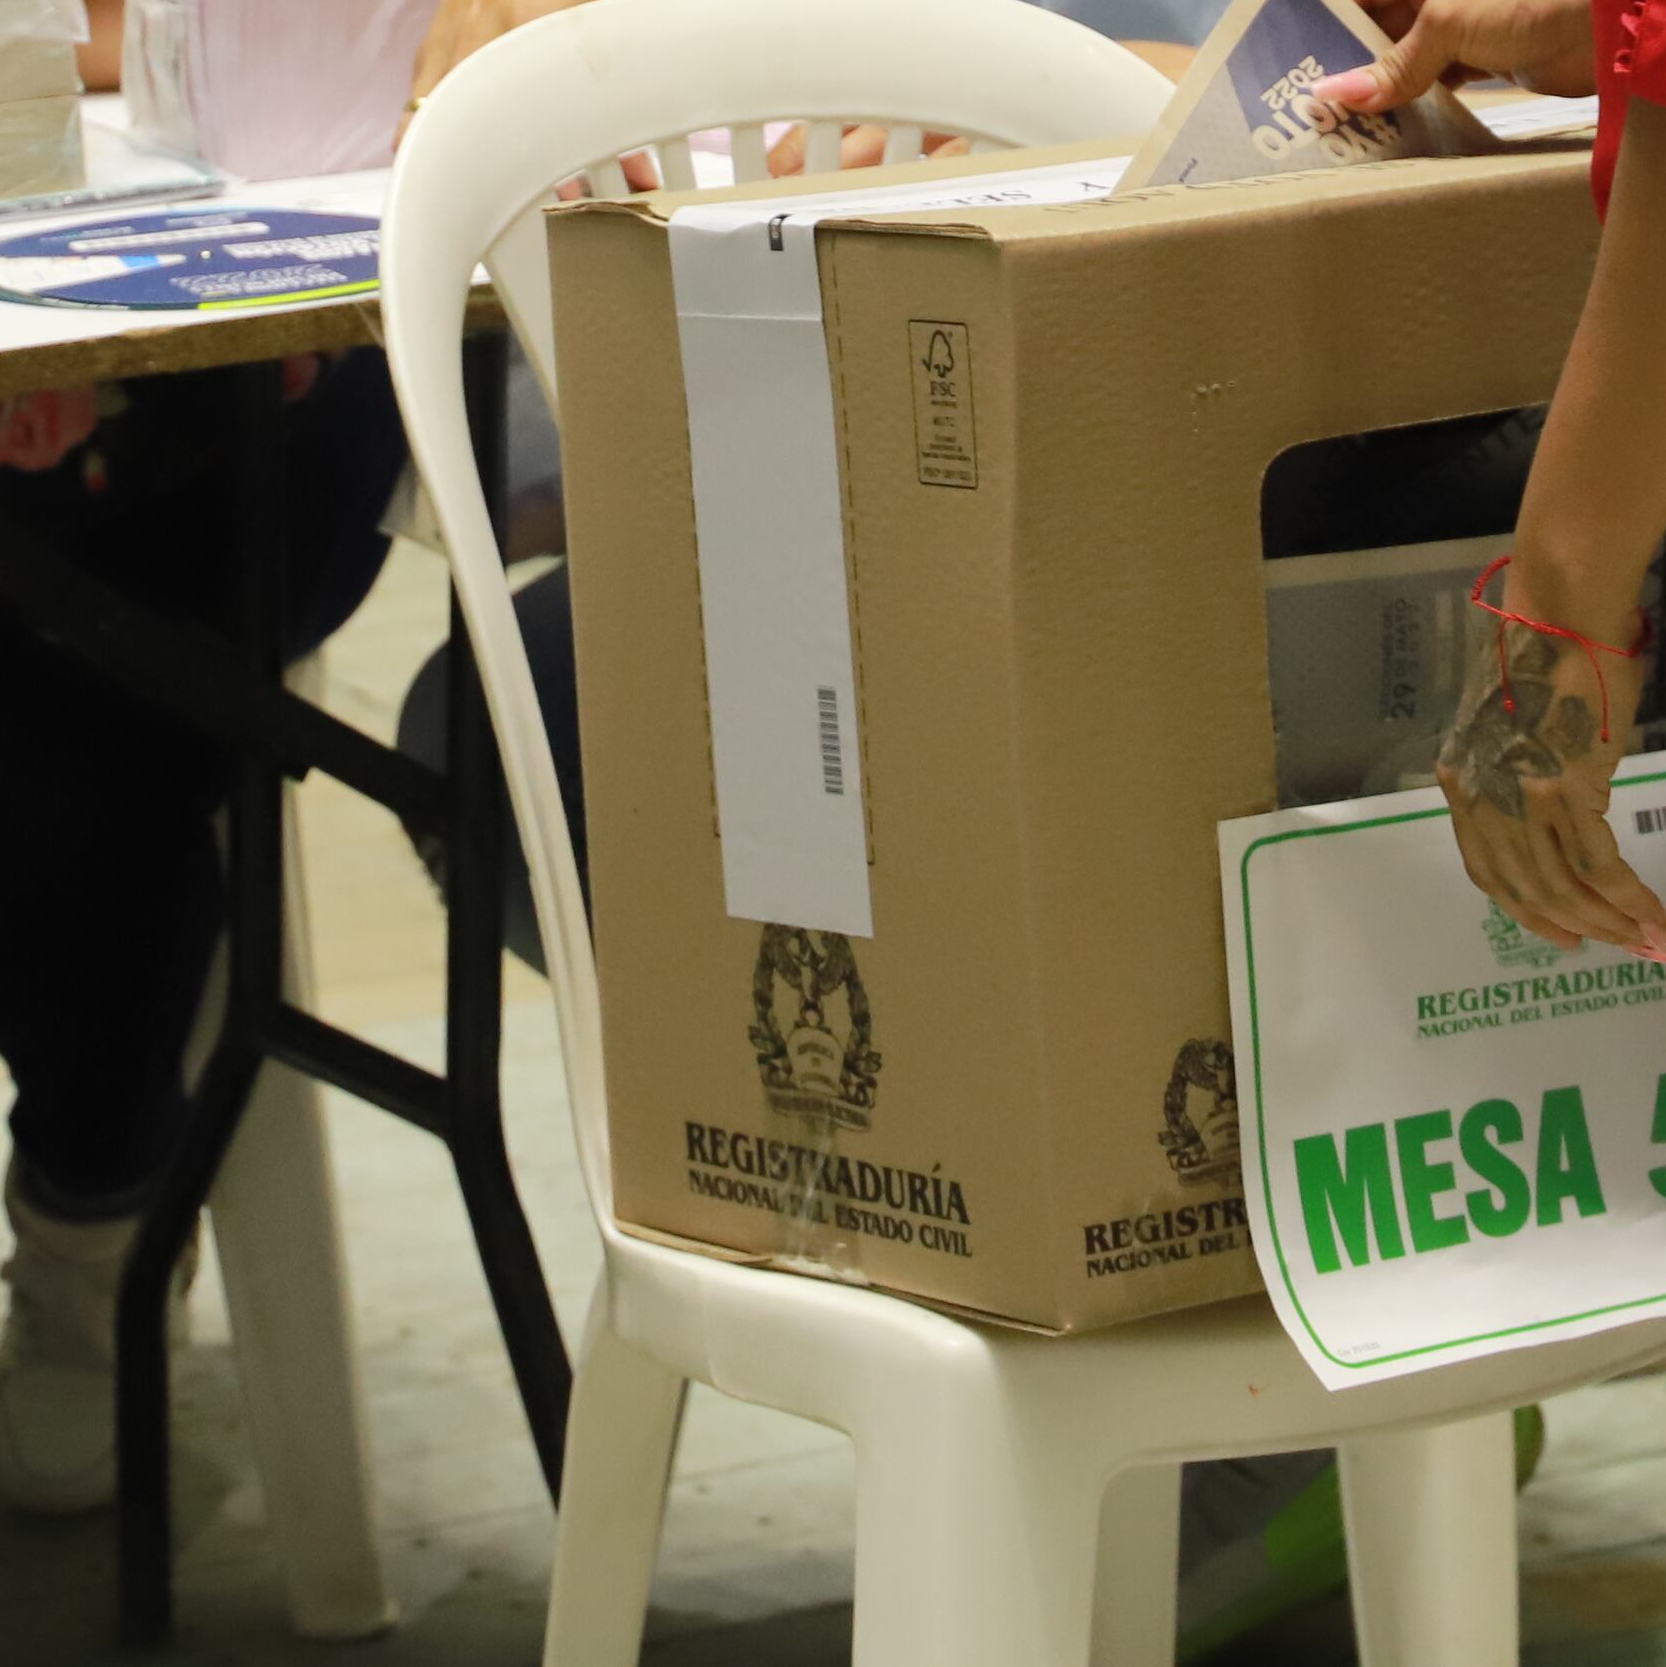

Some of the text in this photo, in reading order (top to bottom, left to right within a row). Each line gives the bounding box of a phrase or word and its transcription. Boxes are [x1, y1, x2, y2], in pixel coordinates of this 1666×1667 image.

[1260, 55, 1324, 111] 2022
[1417, 986, 1666, 1038] NACIONAL DEL ESTADO CIVIL
[685, 1121, 971, 1226] REGISTRADURÍA
[1293, 1085, 1607, 1274] MESA
[688, 1168, 783, 1214] NACIONAL
[835, 1203, 913, 1244] ESTADO
[920, 1223, 973, 1258] CIVIL
[1084, 1197, 1247, 1256] REGISTR
[1087, 1232, 1240, 1278] NACIONAL DEL
